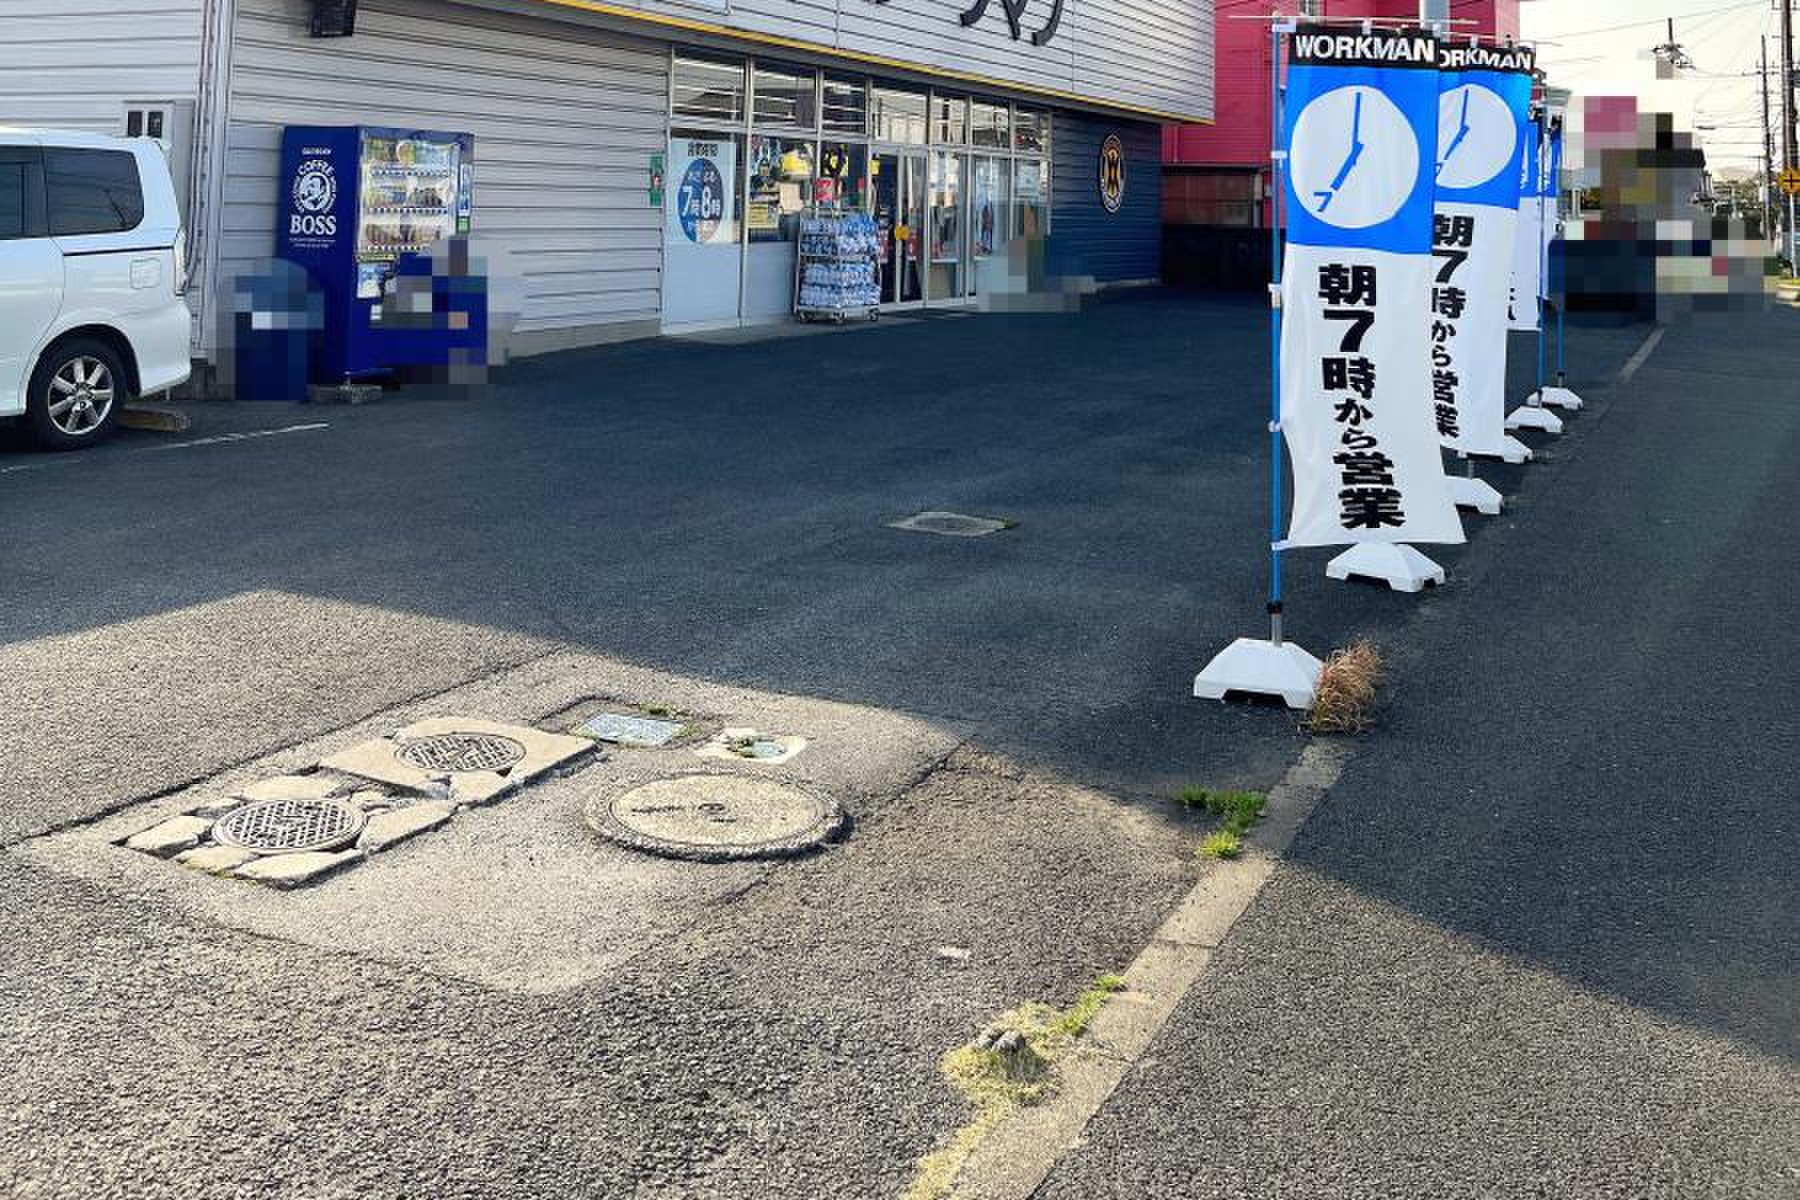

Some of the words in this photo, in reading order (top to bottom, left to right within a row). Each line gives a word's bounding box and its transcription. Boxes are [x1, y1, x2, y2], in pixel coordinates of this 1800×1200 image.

[1295, 35, 1436, 62] WORKMAN
[1439, 48, 1532, 70] ORKMAN
[1313, 191, 1333, 212] 7
[289, 215, 336, 235] BOSS
[1318, 263, 1406, 529] 朝7時から営業
